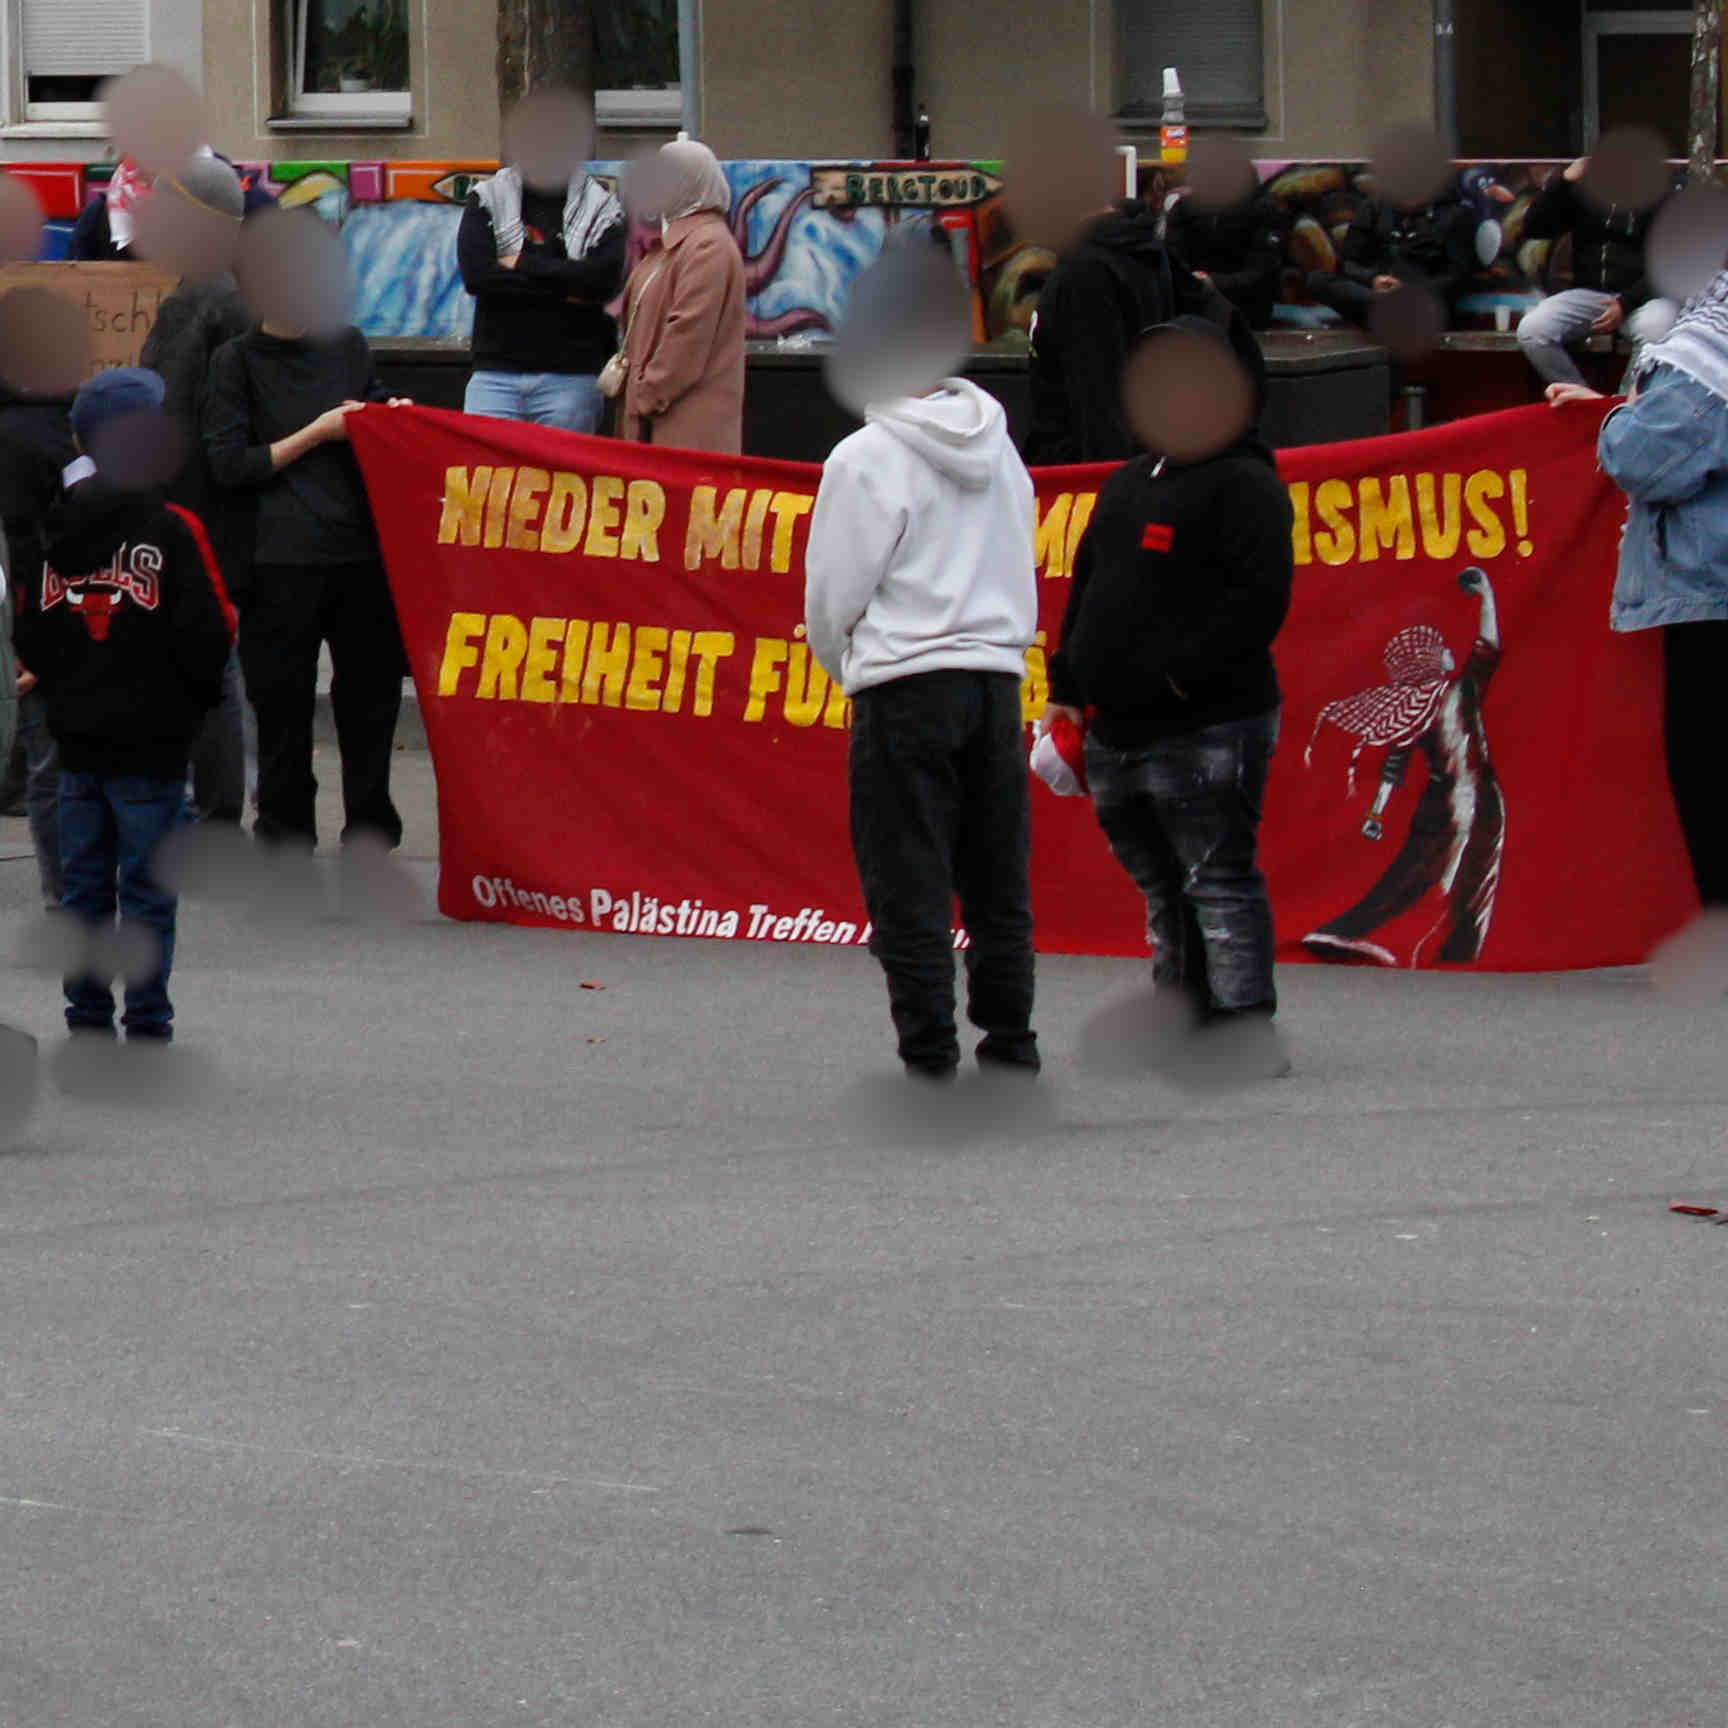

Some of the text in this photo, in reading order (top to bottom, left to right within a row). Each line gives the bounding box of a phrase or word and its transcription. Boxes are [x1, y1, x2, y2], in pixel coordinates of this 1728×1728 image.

[437, 465, 666, 562] NIEDER
[684, 485, 815, 574] MIT
[438, 612, 735, 717] FREIHEIT
[472, 874, 585, 923] Offenes
[590, 888, 741, 940] Palästina
[746, 904, 858, 945] Treffen
